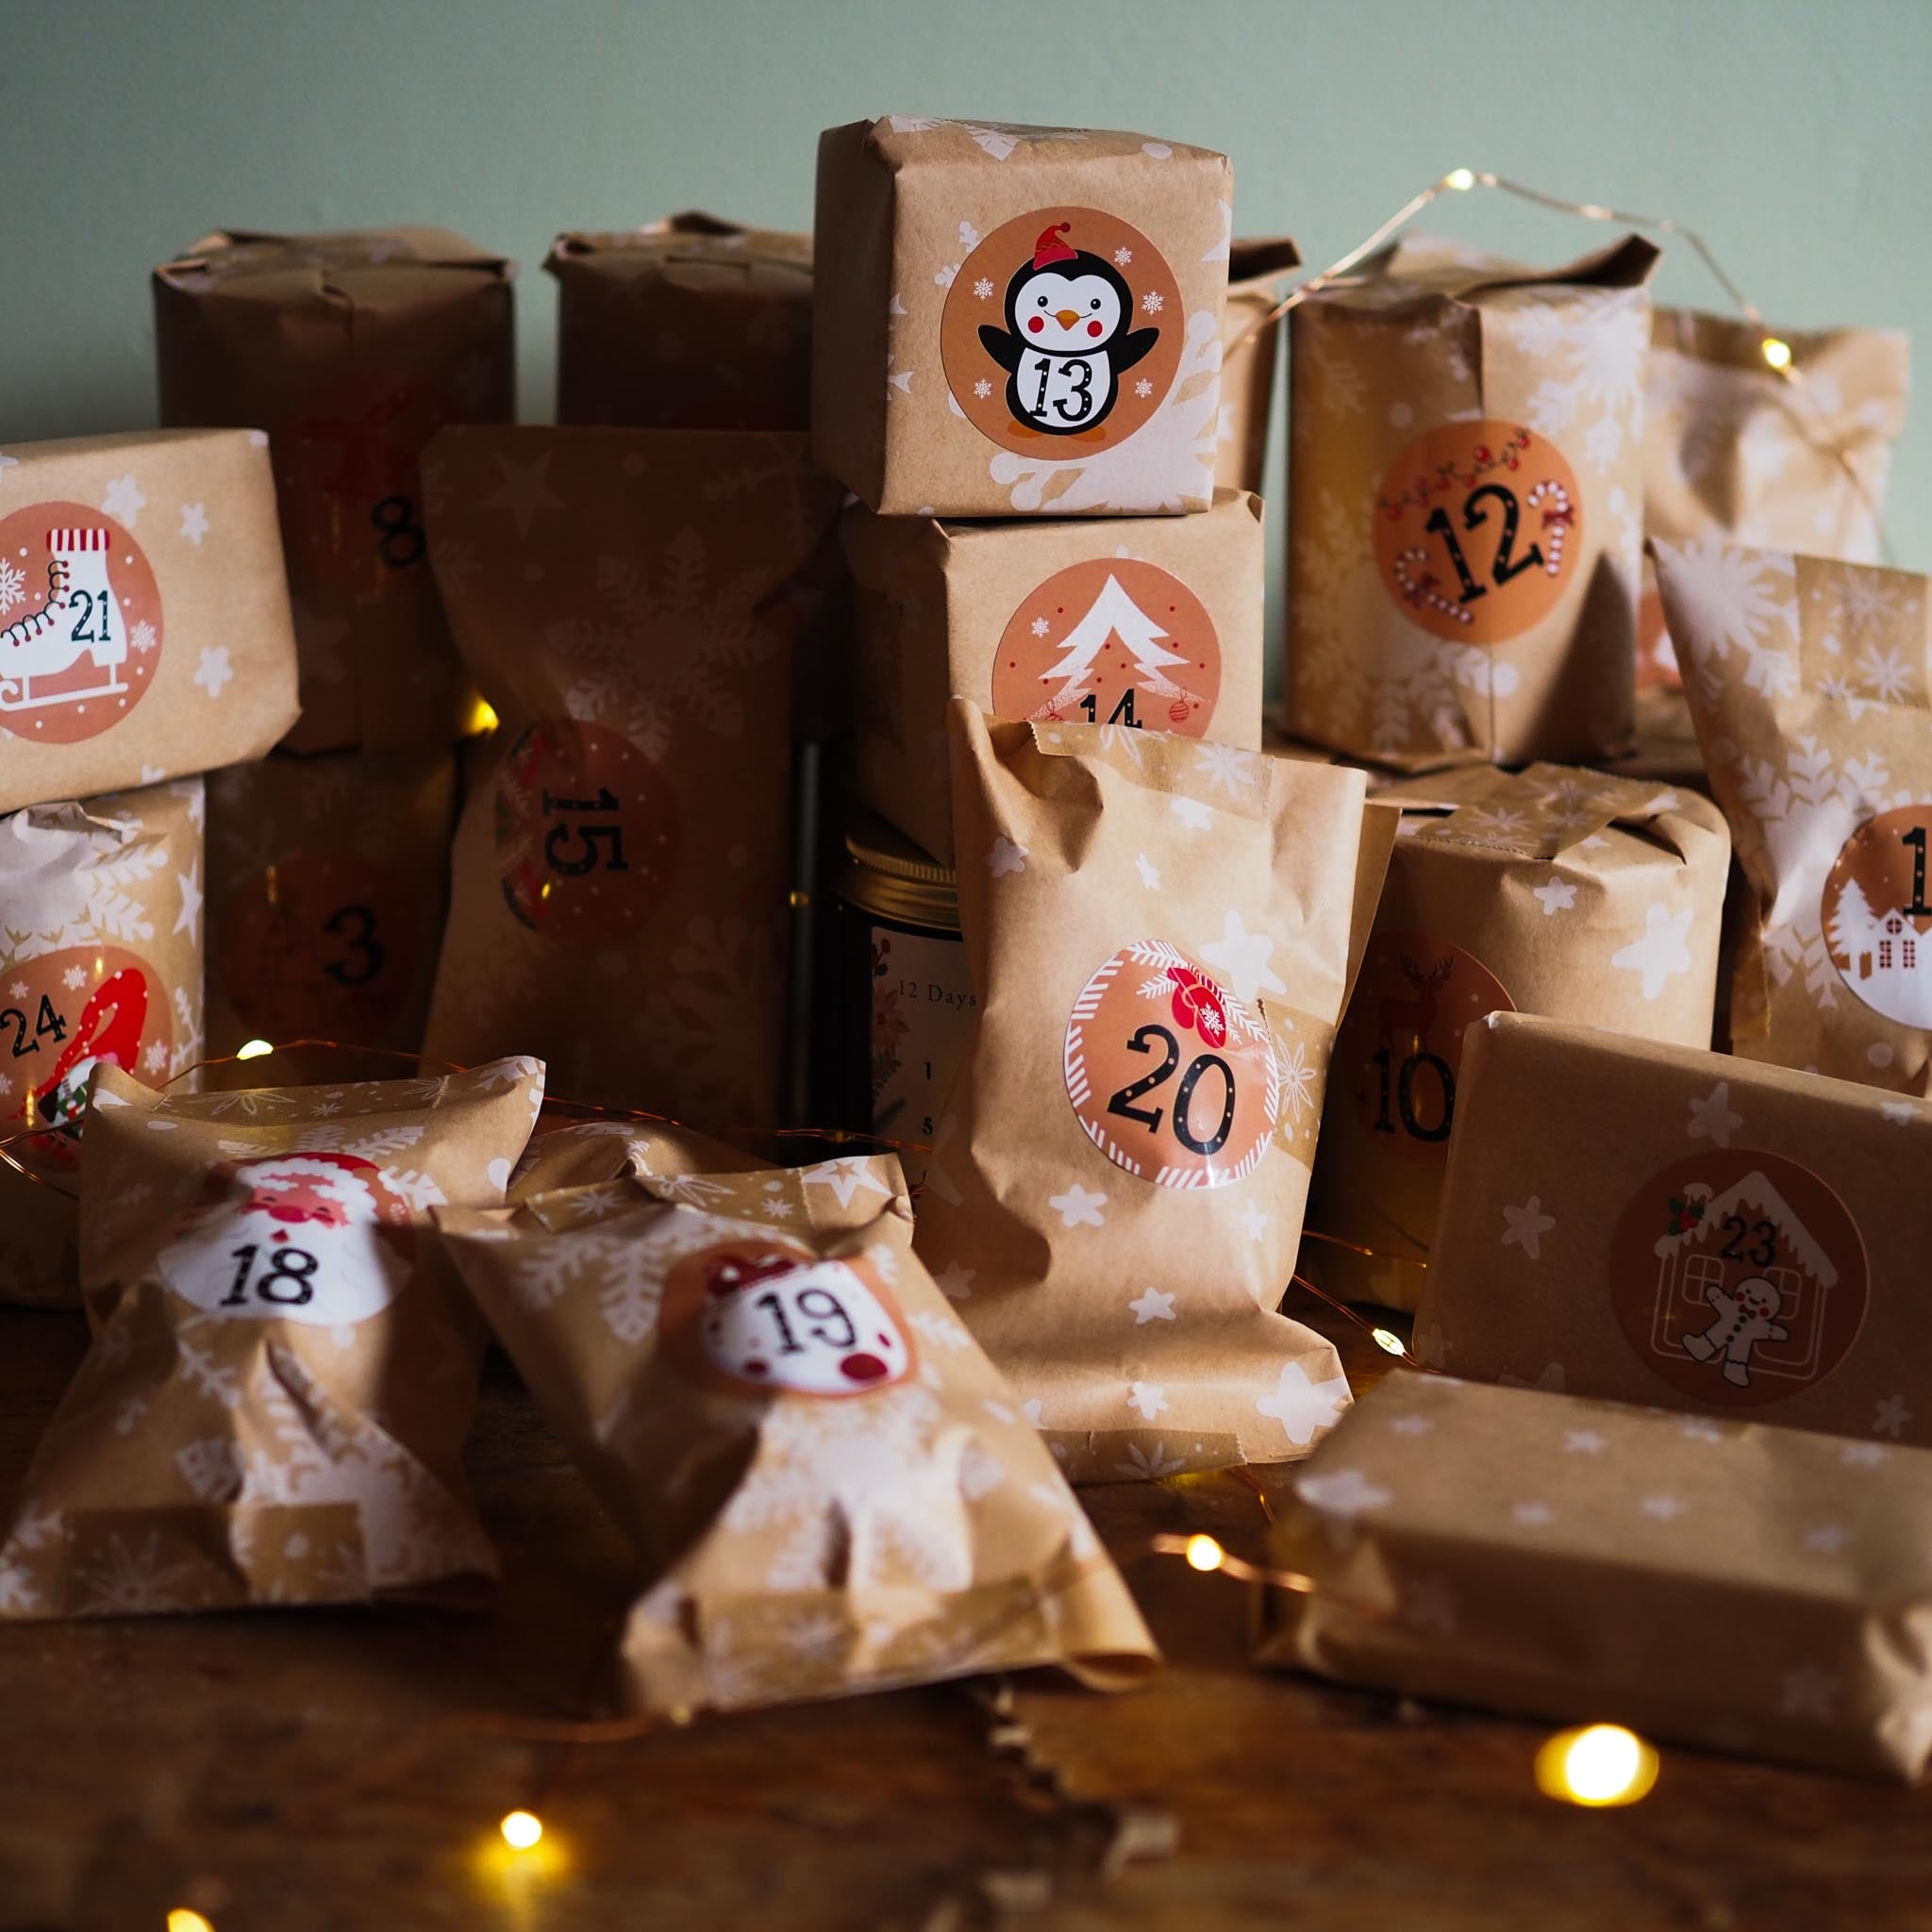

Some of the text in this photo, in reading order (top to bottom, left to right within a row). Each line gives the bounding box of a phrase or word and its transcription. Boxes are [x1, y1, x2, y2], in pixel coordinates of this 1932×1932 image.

[1028, 358, 1094, 423] 13
[372, 496, 426, 569] 8
[1424, 484, 1544, 604] 12
[69, 589, 112, 643] 21
[541, 787, 629, 876] 15
[325, 906, 385, 985] 3
[0, 994, 66, 1058] 24
[899, 980, 977, 1009] 12 Days
[1108, 1024, 1235, 1157] 20
[1372, 1047, 1457, 1143] 10
[922, 1116, 934, 1137] 5
[220, 1243, 318, 1307] 18
[1720, 1216, 1777, 1268] 23
[758, 1287, 858, 1355] 19
